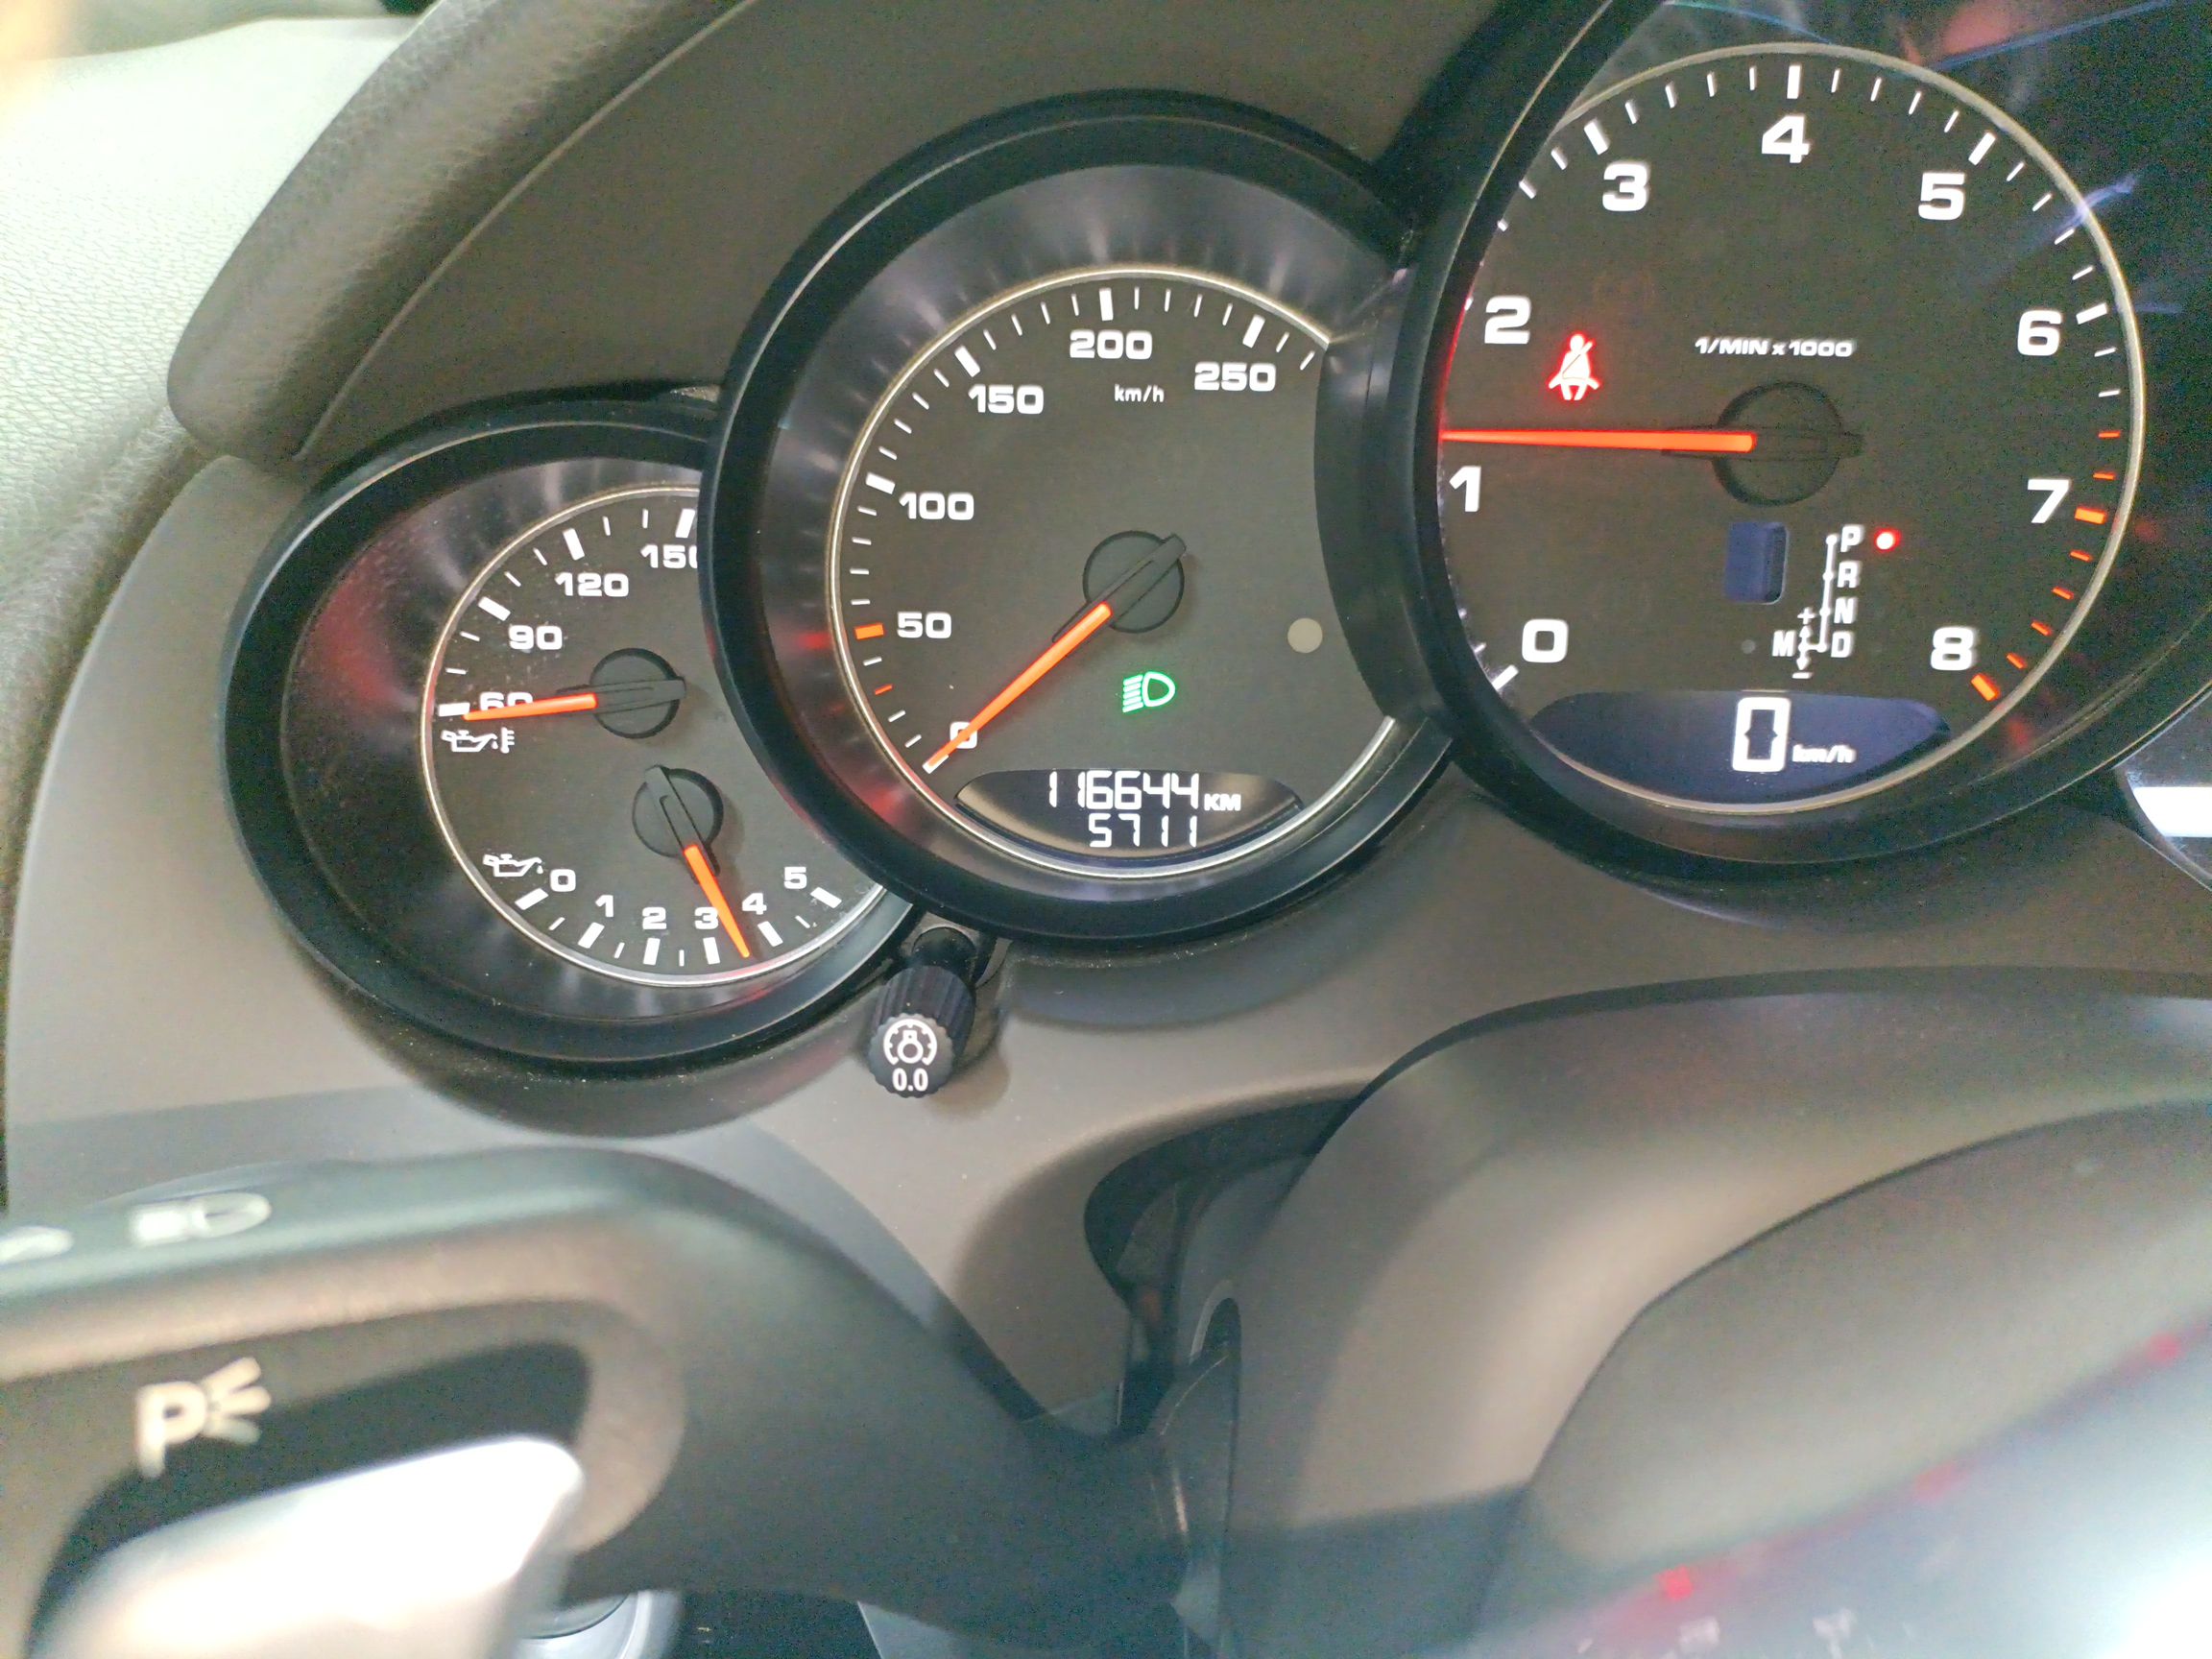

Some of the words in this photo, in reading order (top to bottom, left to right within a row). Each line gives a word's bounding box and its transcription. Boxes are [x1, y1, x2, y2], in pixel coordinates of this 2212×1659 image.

[1761, 115, 1810, 163] 4
[1602, 162, 1649, 211] 3
[1918, 173, 1964, 221] 5
[1484, 297, 1530, 345] 2
[2017, 310, 2062, 356] 6
[1070, 330, 1152, 359] 200
[1695, 338, 1768, 357] 1/MIN
[1194, 364, 1276, 392] 250
[970, 385, 1044, 414] 150
[1115, 385, 1165, 402] km/h
[1450, 468, 1480, 512] 1
[2027, 479, 2069, 523] 7
[899, 493, 974, 520] 100
[1840, 524, 1862, 552] P
[556, 573, 629, 596] 120
[1839, 562, 1858, 588] R
[1835, 597, 1855, 622] N
[509, 626, 563, 650] 90
[898, 613, 951, 638] 50
[1523, 619, 1567, 661] 0
[1772, 634, 1792, 657] M
[1832, 632, 1851, 658] D
[1931, 627, 1978, 670] 8
[1734, 697, 1789, 772] 0
[1048, 770, 1198, 810] 116644
[1205, 794, 1240, 811] KM
[1090, 814, 1197, 848] 5711
[551, 869, 575, 892] 0
[783, 867, 806, 889] 5
[595, 895, 613, 916] 1
[741, 892, 767, 914] 4
[642, 907, 667, 929] 2
[694, 907, 718, 929] 3
[892, 1068, 928, 1091] 0.0
